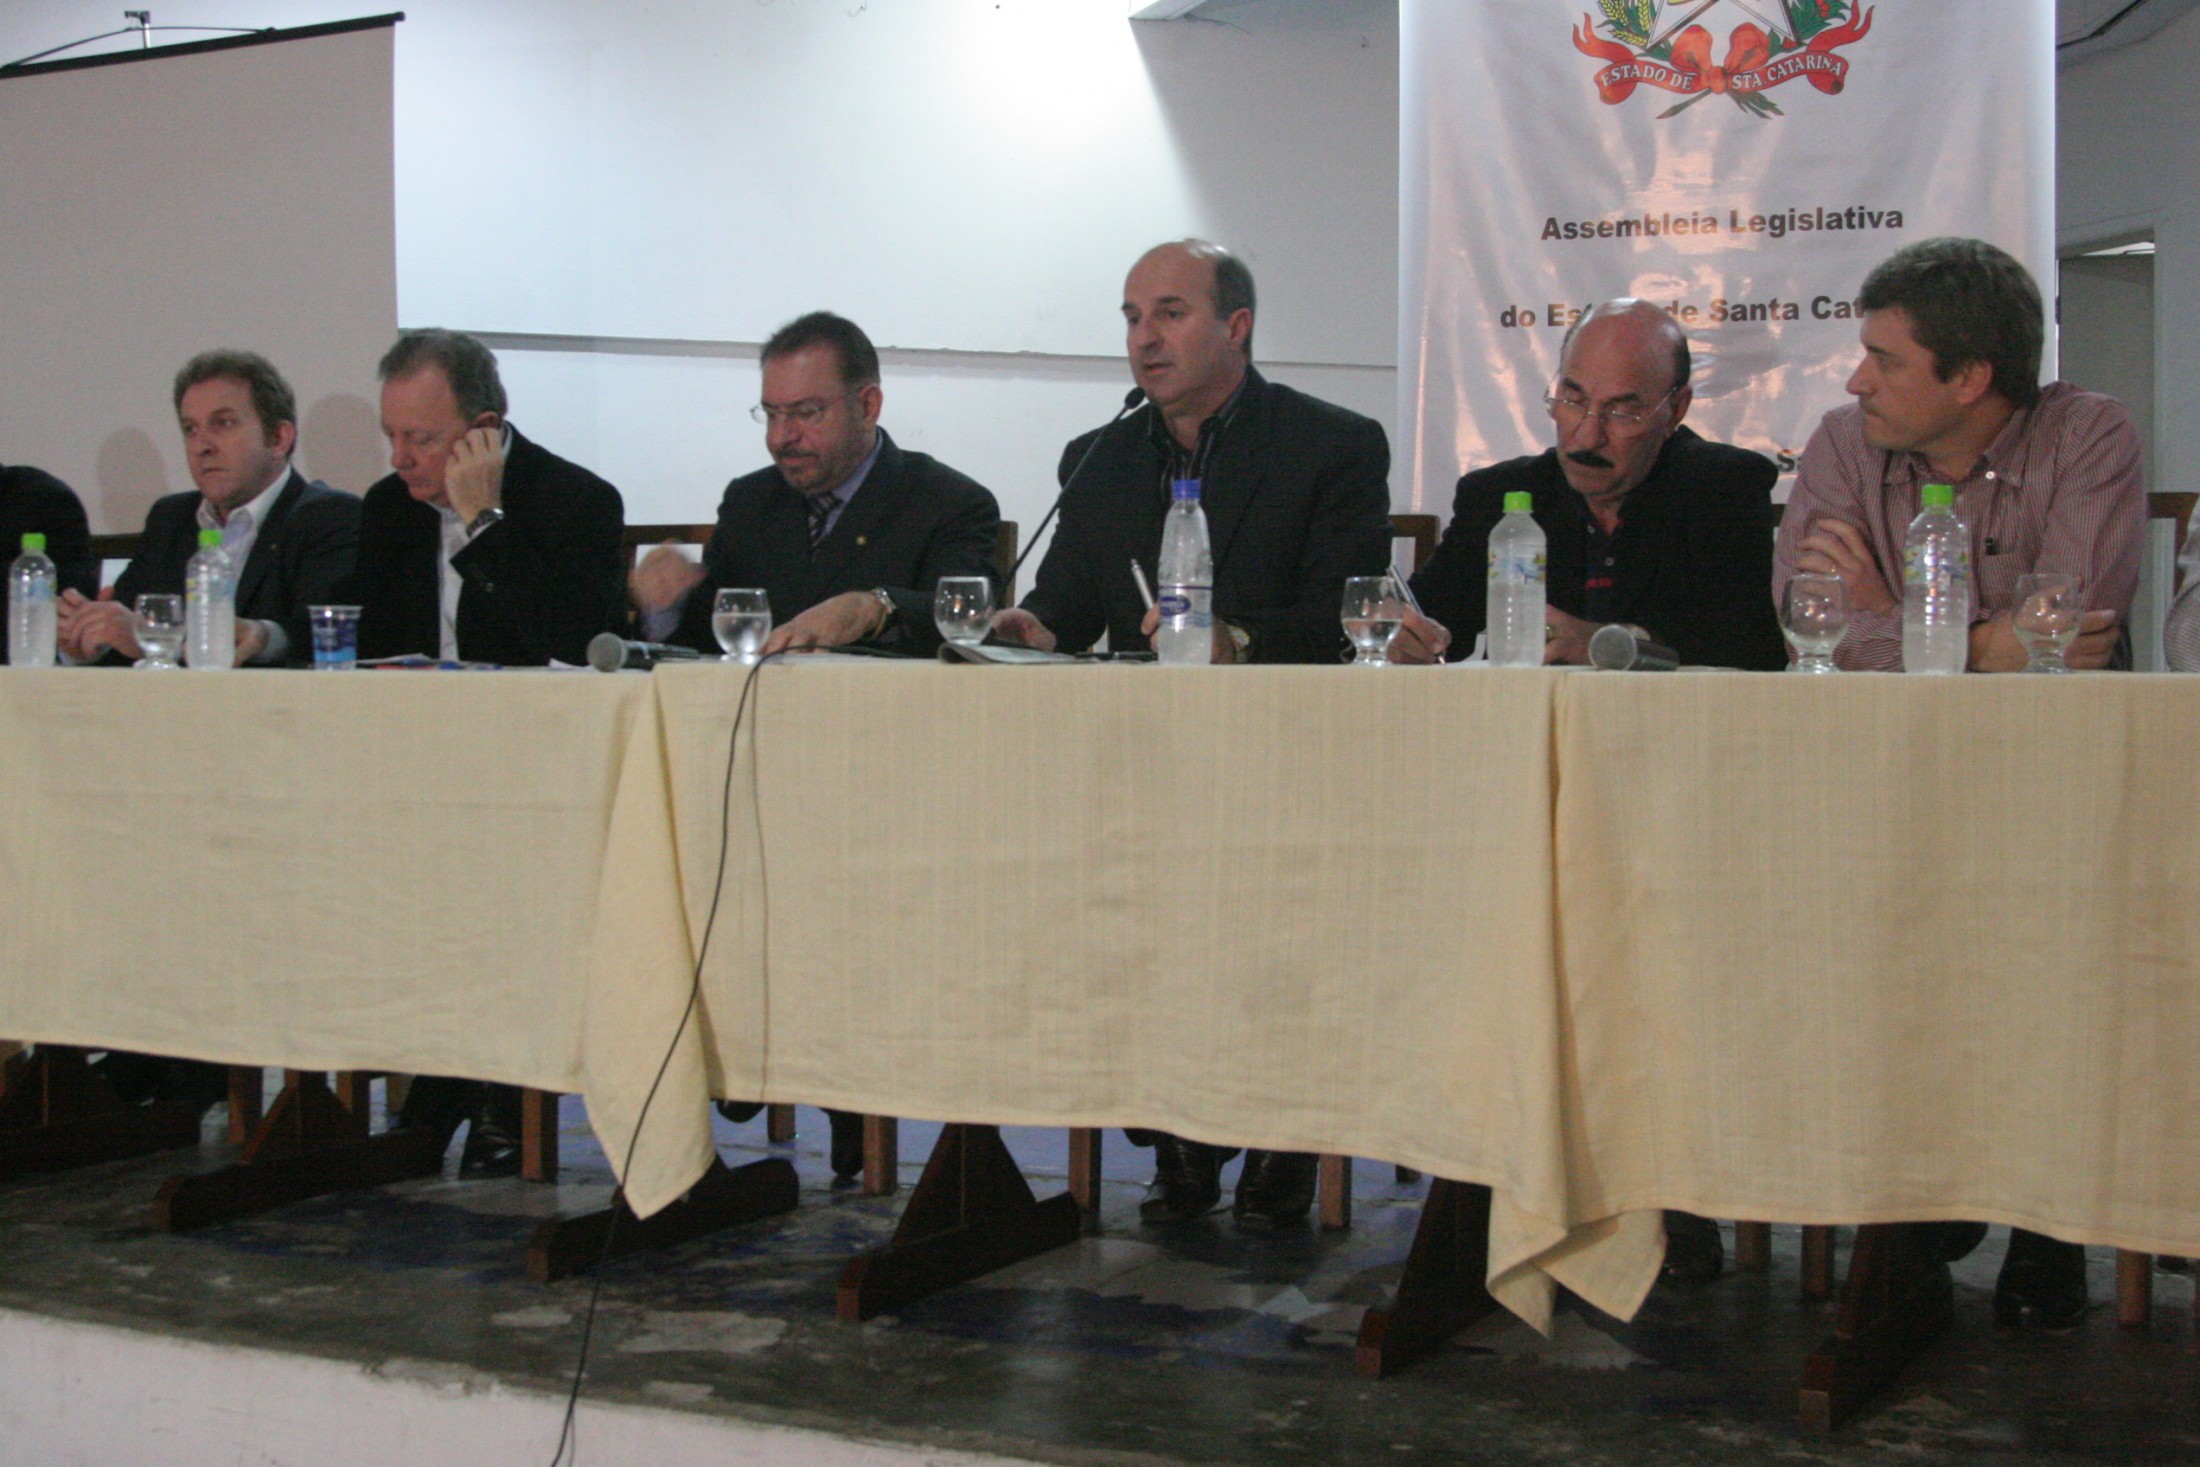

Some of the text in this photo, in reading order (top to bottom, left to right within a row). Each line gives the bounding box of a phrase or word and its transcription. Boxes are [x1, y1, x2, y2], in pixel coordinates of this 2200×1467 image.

[1600, 65, 1666, 87] ESTADO
[1669, 72, 1693, 91] DE
[1767, 55, 1843, 81] CATARINA
[1541, 206, 1903, 241] Assembleia Legislativa
[1500, 305, 1536, 328] do
[1710, 298, 1799, 322] Santa
